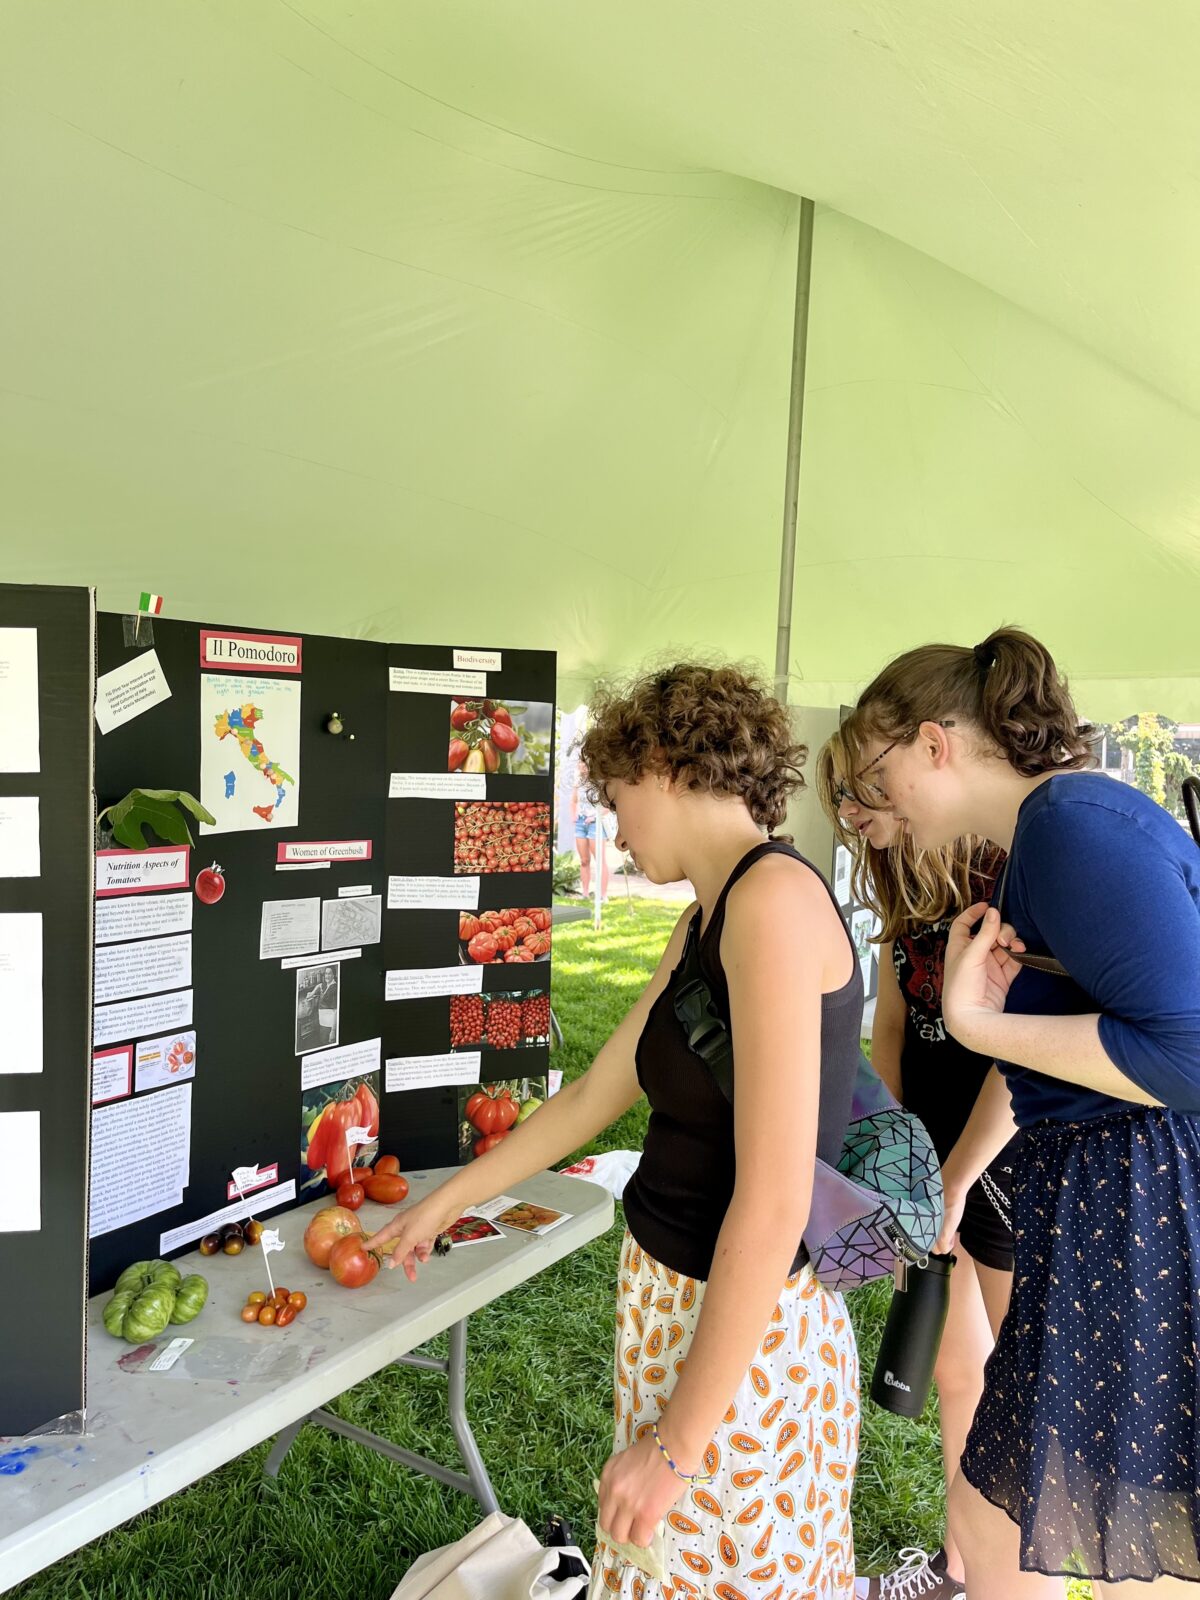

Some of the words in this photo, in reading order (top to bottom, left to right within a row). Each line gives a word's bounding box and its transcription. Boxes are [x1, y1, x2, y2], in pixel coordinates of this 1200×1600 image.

[213, 639, 223, 656] Il
[228, 640, 296, 664] Pomodoro
[457, 655, 496, 665] Biodiversity
[292, 848, 318, 856] Women
[320, 847, 328, 855] of
[329, 846, 364, 856] Greenbush
[106, 862, 141, 871] Nutrition
[142, 861, 169, 870] Aspects
[170, 858, 179, 868] of
[106, 876, 142, 886] Tomatoes
